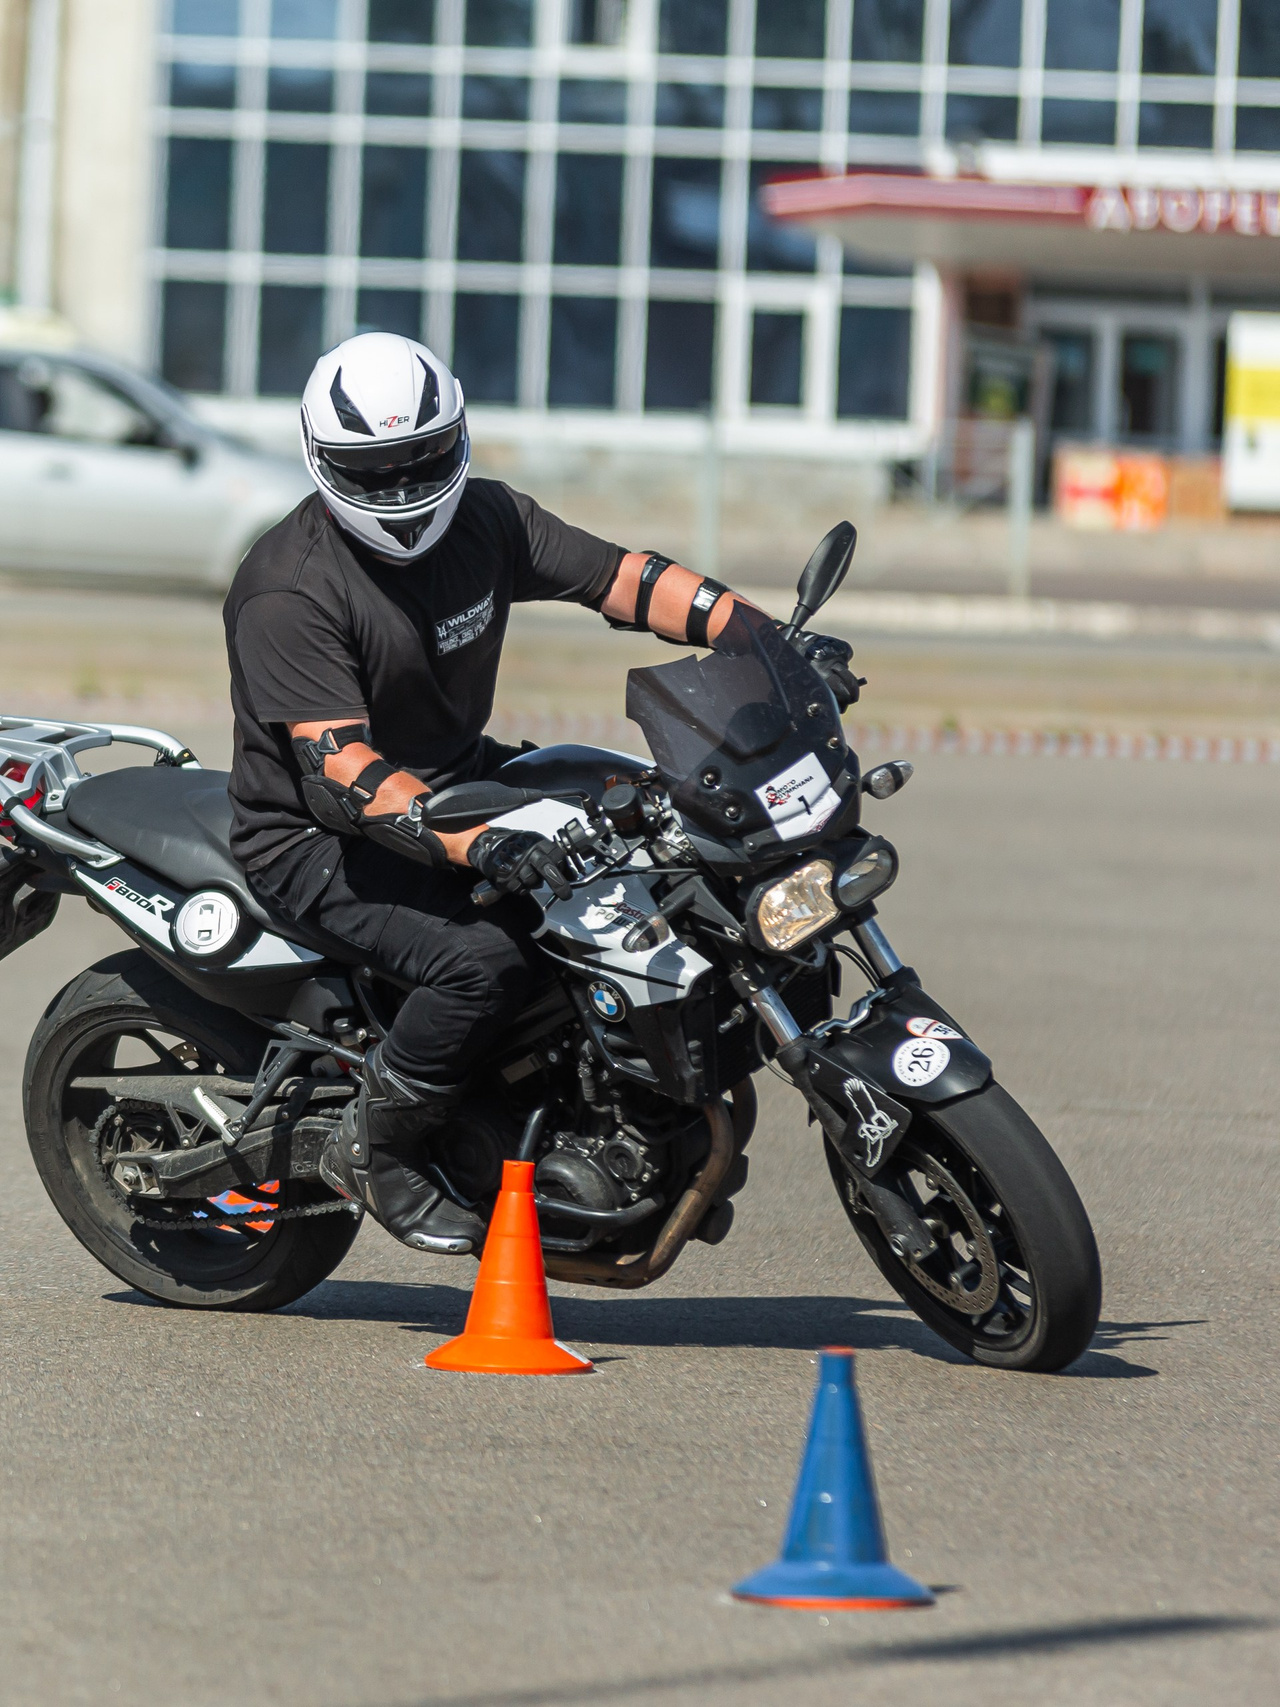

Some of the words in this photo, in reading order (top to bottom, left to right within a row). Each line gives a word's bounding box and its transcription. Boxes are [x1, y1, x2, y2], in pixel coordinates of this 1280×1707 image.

[380, 416, 410, 428] HIZER
[798, 795, 812, 815] 1
[104, 877, 175, 922] F800R
[616, 902, 646, 920] Castr
[590, 983, 620, 1000] BMW
[908, 1047, 935, 1072] 26
